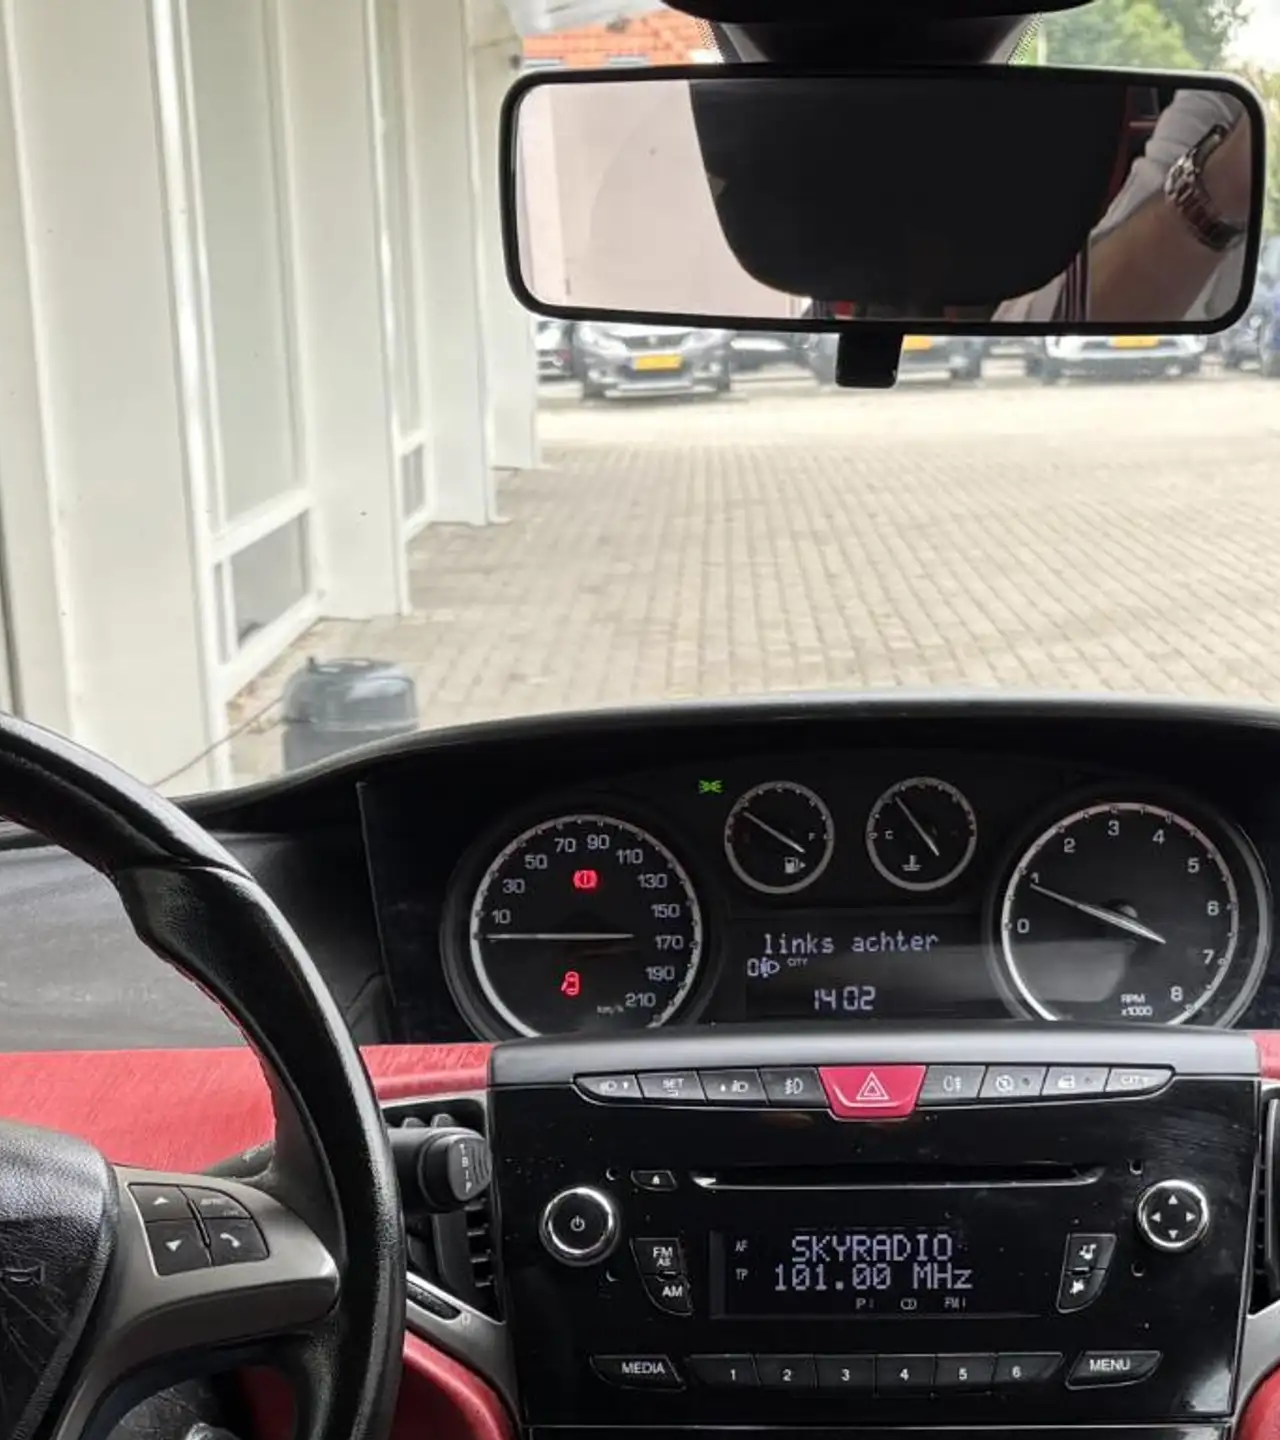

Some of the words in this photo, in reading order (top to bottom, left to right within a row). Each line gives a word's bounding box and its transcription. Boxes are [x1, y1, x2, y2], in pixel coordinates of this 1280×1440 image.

[1107, 820, 1119, 836] 3
[587, 834, 609, 850] 90
[1152, 829, 1164, 844] 4
[554, 838, 576, 852] 70
[1063, 838, 1076, 853] 2
[524, 854, 547, 869] 50
[616, 849, 643, 864] 110
[1187, 858, 1199, 873] 5
[637, 873, 668, 889] 130
[1030, 872, 1039, 884] 1
[503, 878, 525, 894] 30
[651, 903, 680, 918] 150
[1207, 901, 1219, 916] 6
[492, 909, 511, 924] 10
[1017, 918, 1029, 934] 0
[654, 935, 684, 949] 170
[764, 932, 834, 954] links
[851, 930, 939, 952] achter
[786, 957, 808, 967] CITY
[1203, 949, 1215, 965] 7
[645, 966, 675, 981] 190
[625, 993, 656, 1008] 210
[1121, 993, 1145, 1004] RPM
[1170, 986, 1183, 1002] 8
[662, 1078, 684, 1089] SET
[653, 1247, 673, 1258] FM
[735, 1240, 748, 1252] AF
[792, 1234, 953, 1262] SKYRADIO
[656, 1258, 671, 1267] AS
[735, 1269, 748, 1281] TP
[775, 1263, 891, 1291] 101.00
[913, 1262, 973, 1290] MHz
[662, 1286, 683, 1297] AM
[621, 1361, 666, 1375] MEDIA
[1012, 1366, 1021, 1378] 6
[1089, 1358, 1131, 1373] MENU
[730, 1369, 737, 1381] 1
[782, 1369, 791, 1381] 2
[841, 1369, 850, 1381] 3
[900, 1368, 909, 1381] 4
[959, 1368, 968, 1380] 5
